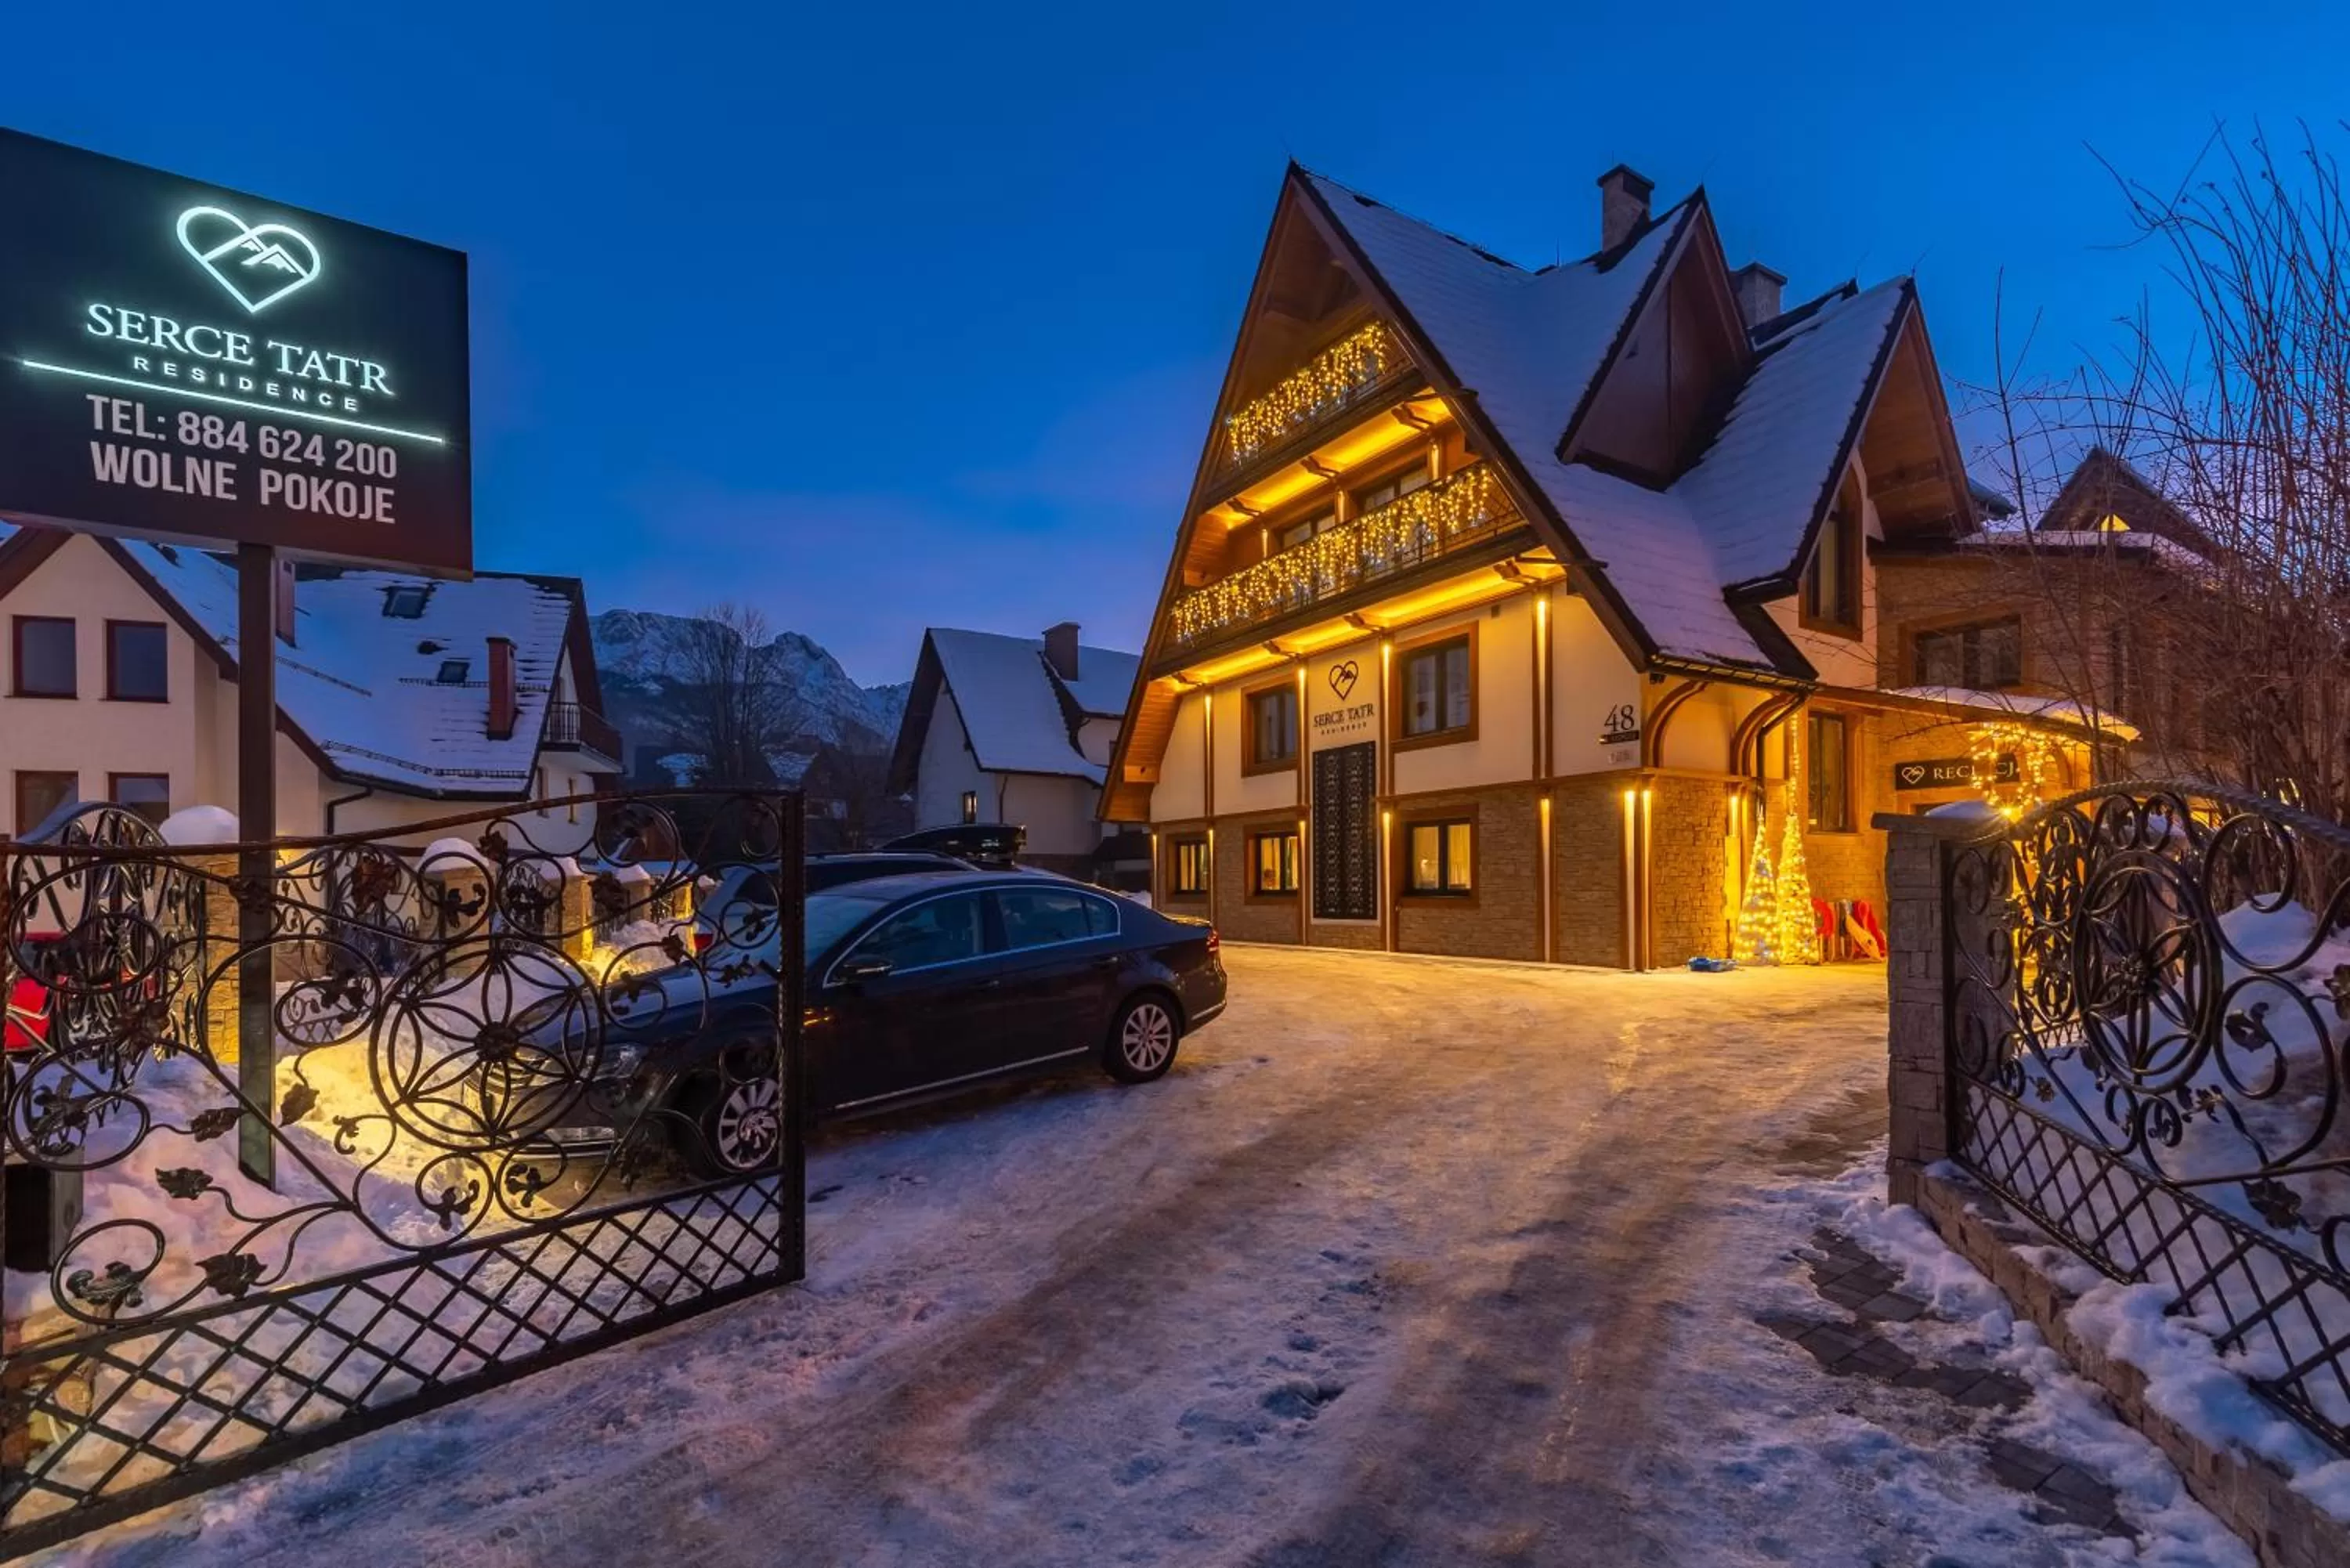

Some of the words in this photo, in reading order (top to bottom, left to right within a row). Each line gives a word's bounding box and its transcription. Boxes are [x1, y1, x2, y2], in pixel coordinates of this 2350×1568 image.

[86, 302, 255, 366] SERCE
[267, 339, 396, 396] TATR
[134, 357, 360, 412] RESIDENCE
[86, 394, 166, 441] TEL:
[178, 411, 249, 454] 884
[259, 425, 326, 468] 624
[335, 439, 397, 479] 200
[91, 441, 237, 500] WOLNE
[260, 470, 396, 524] POKOJE
[1603, 703, 1635, 732] 48
